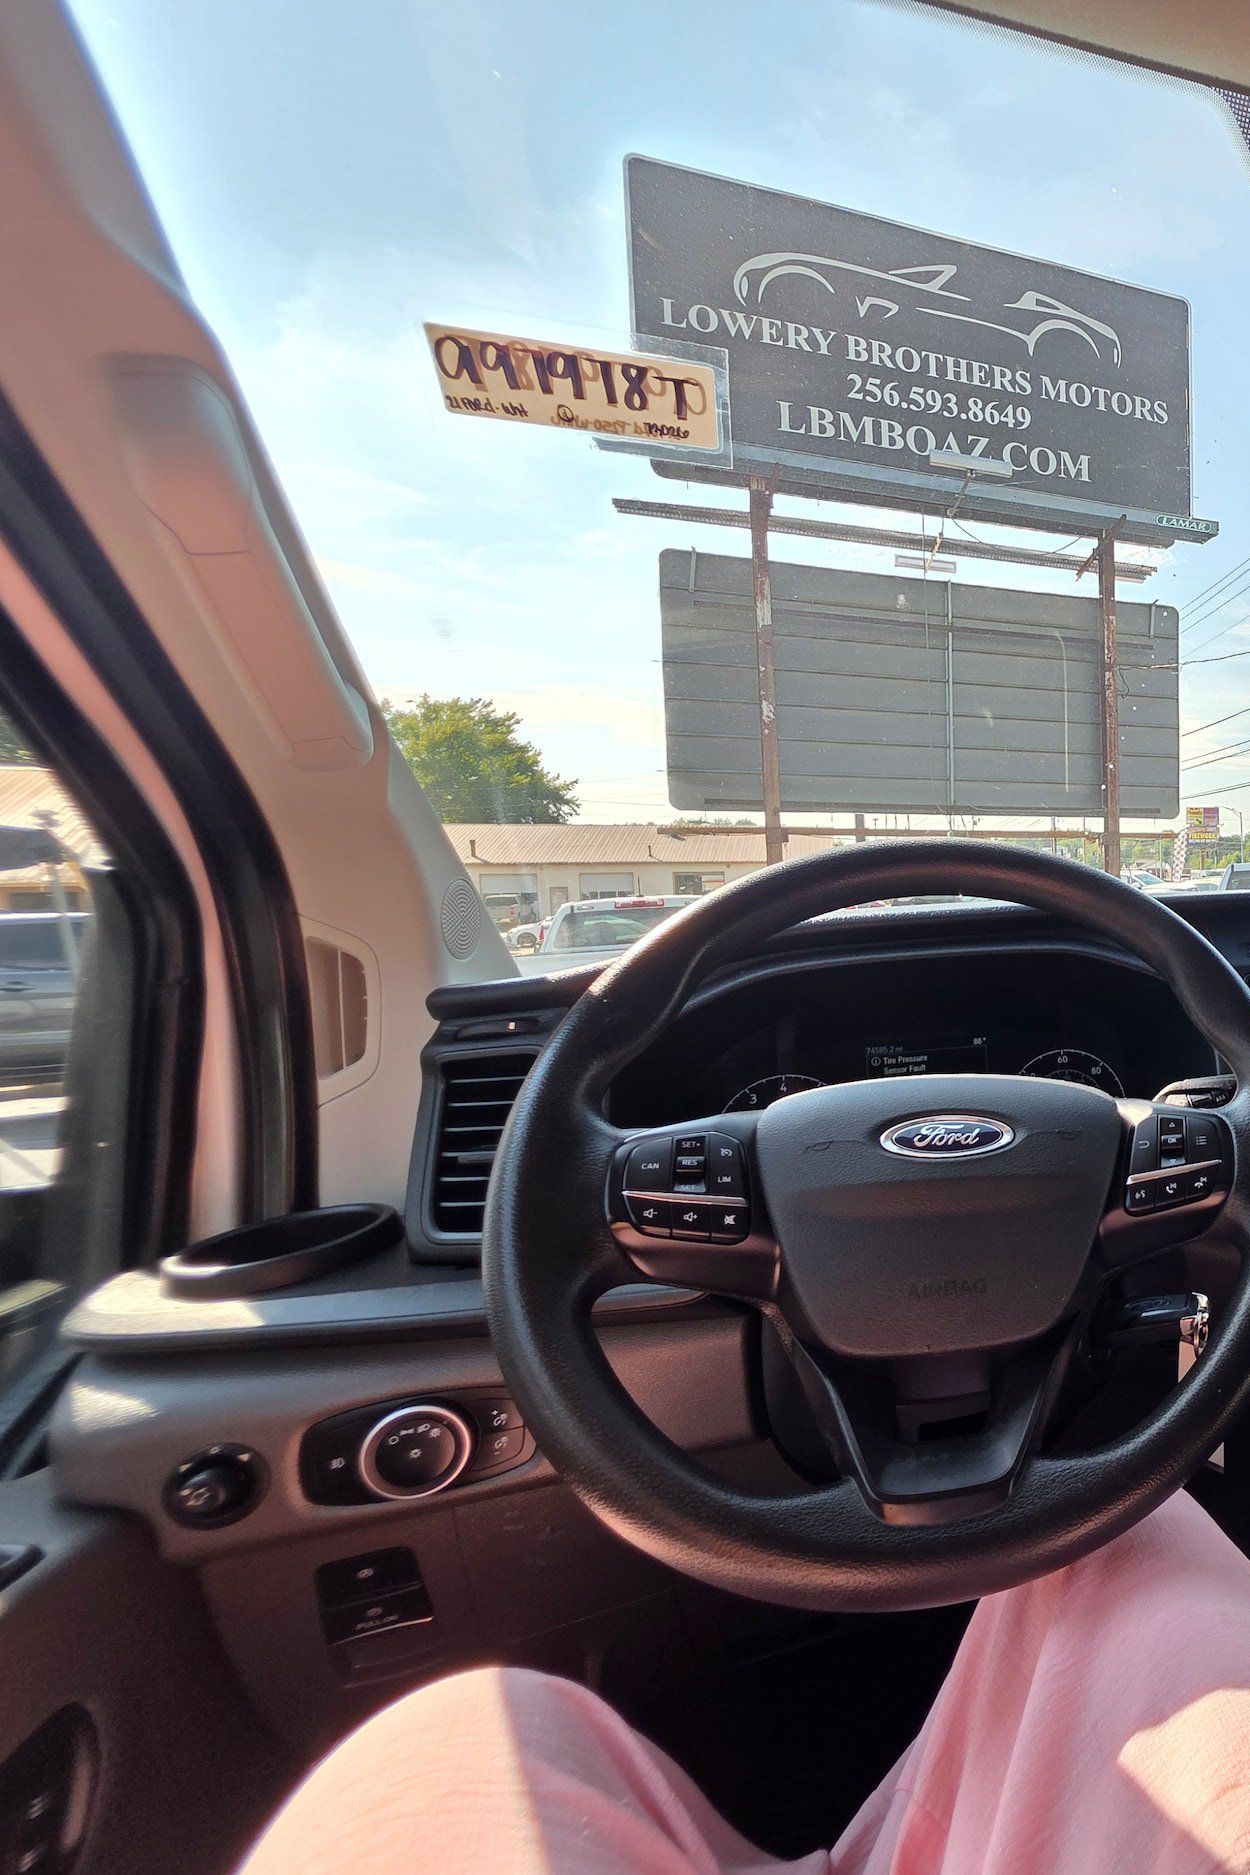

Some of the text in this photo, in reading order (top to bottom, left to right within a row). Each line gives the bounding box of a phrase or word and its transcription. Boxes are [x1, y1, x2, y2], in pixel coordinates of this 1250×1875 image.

[661, 297, 1169, 425] LOWERY BROTHERS MOTORS
[846, 373, 1032, 430] 256.593.8649
[776, 400, 1092, 482] LBMBOAZCOM
[1161, 517, 1207, 531] LAMAR
[883, 1055, 928, 1065] Tire Pressure
[1057, 1055, 1068, 1063] 60
[884, 1064, 926, 1075] Sensor Fault
[1091, 1066, 1102, 1075] 80
[780, 1083, 788, 1092] 4
[749, 1093, 757, 1104] 3
[913, 1123, 981, 1147] Ford
[641, 1162, 660, 1170] CAN
[682, 1158, 698, 1166] RES
